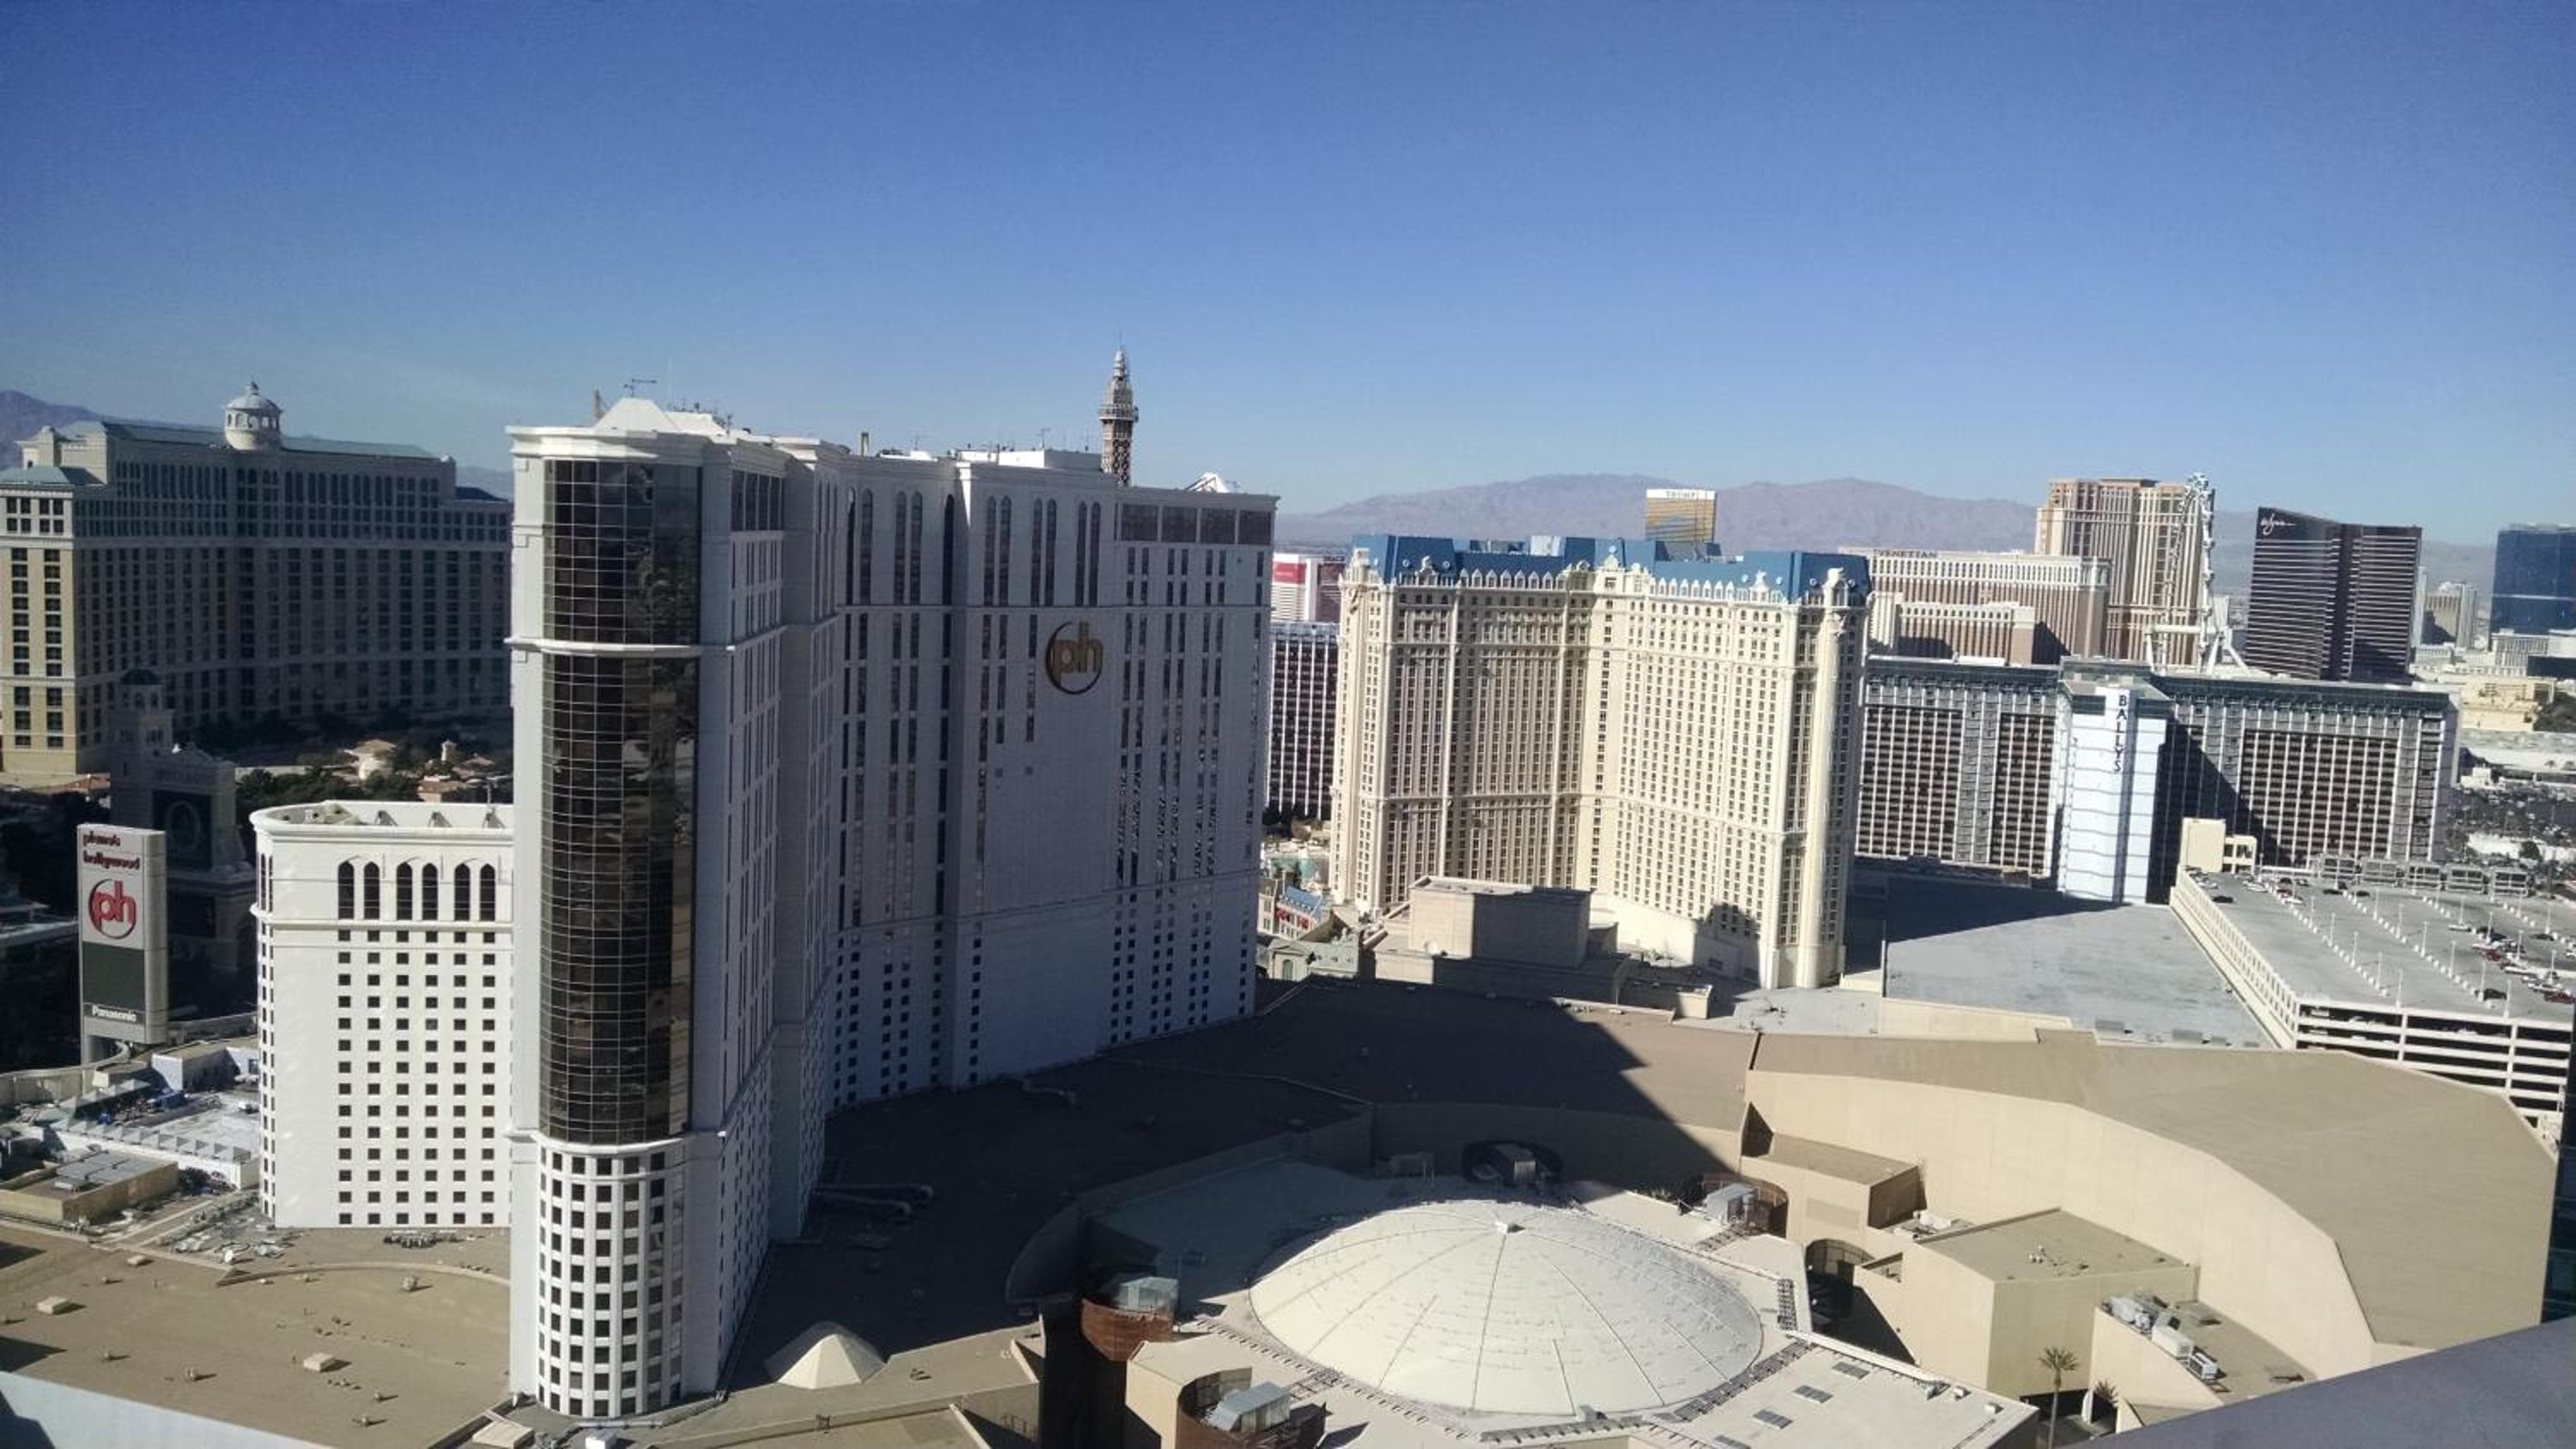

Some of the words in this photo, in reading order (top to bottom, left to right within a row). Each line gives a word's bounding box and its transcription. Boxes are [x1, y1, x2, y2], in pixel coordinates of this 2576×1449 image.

[1048, 621, 1103, 688] ph
[92, 880, 137, 931] ph
[92, 1004, 137, 1022] Panasonic
